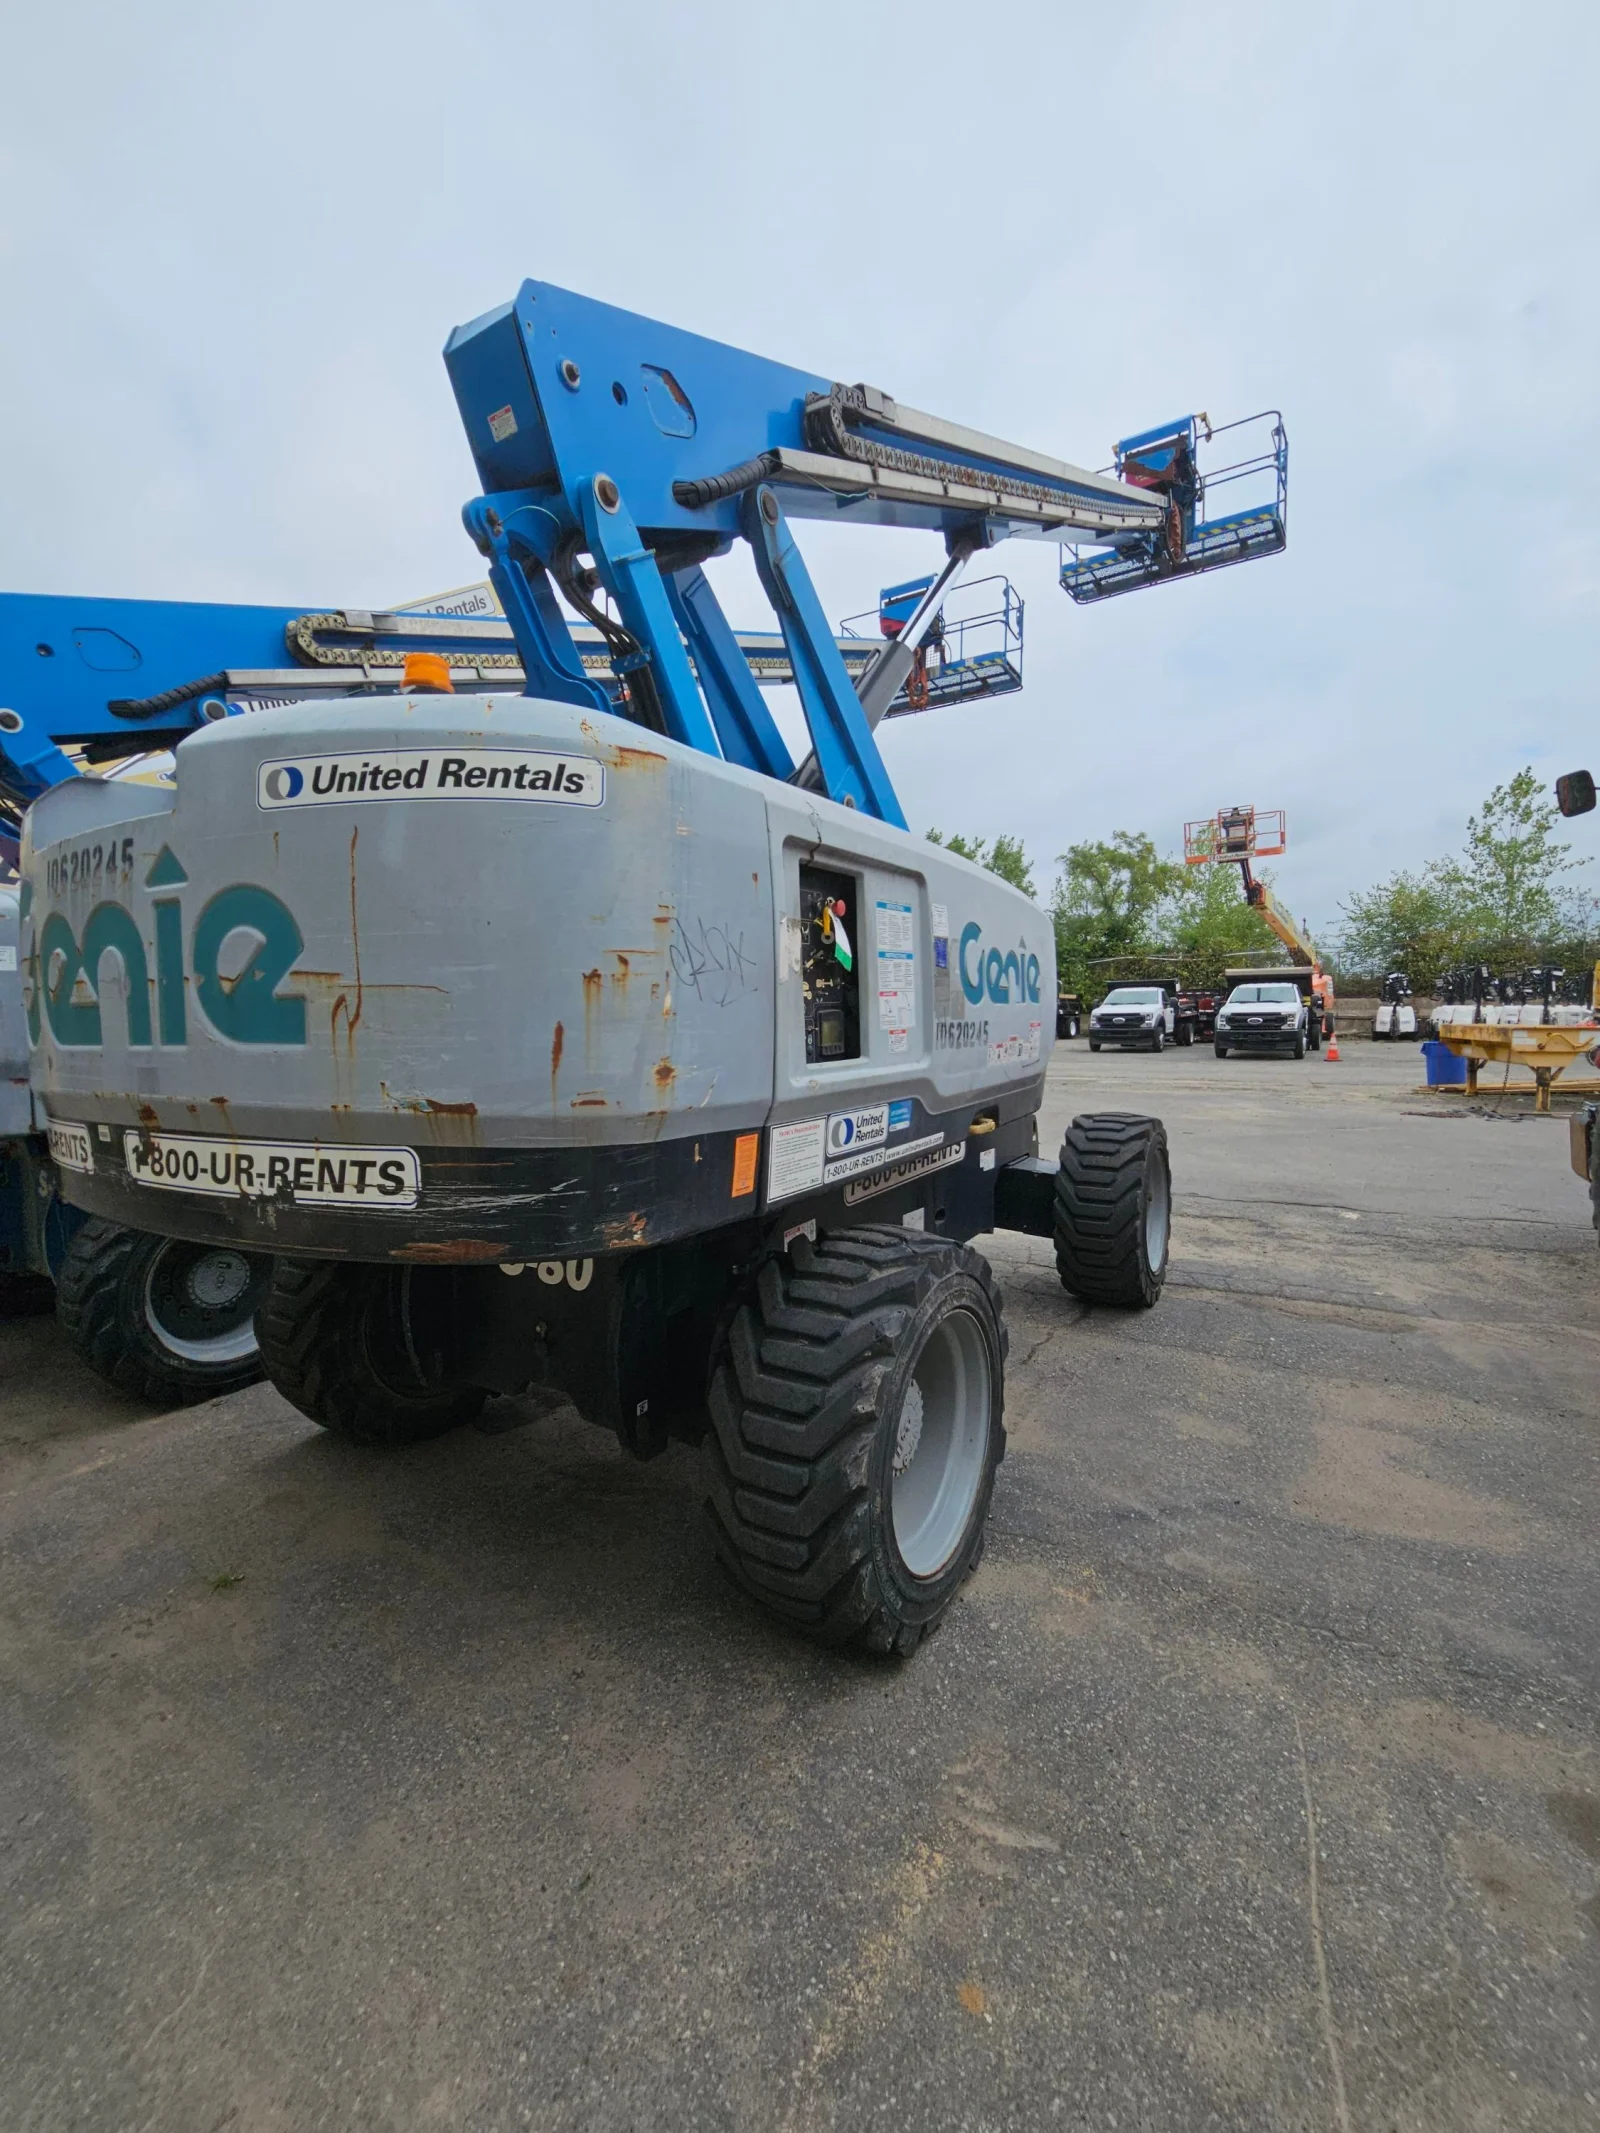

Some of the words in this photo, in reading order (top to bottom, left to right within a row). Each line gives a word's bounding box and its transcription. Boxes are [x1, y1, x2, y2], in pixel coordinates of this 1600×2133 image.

[312, 759, 429, 795] United
[437, 758, 585, 794] Rentals
[20, 843, 308, 1048] enie
[959, 921, 1041, 1005] Genie
[855, 1127, 885, 1143] Rentals
[856, 1111, 884, 1129] United
[827, 1151, 883, 1179] 1-800-UR-RENTS
